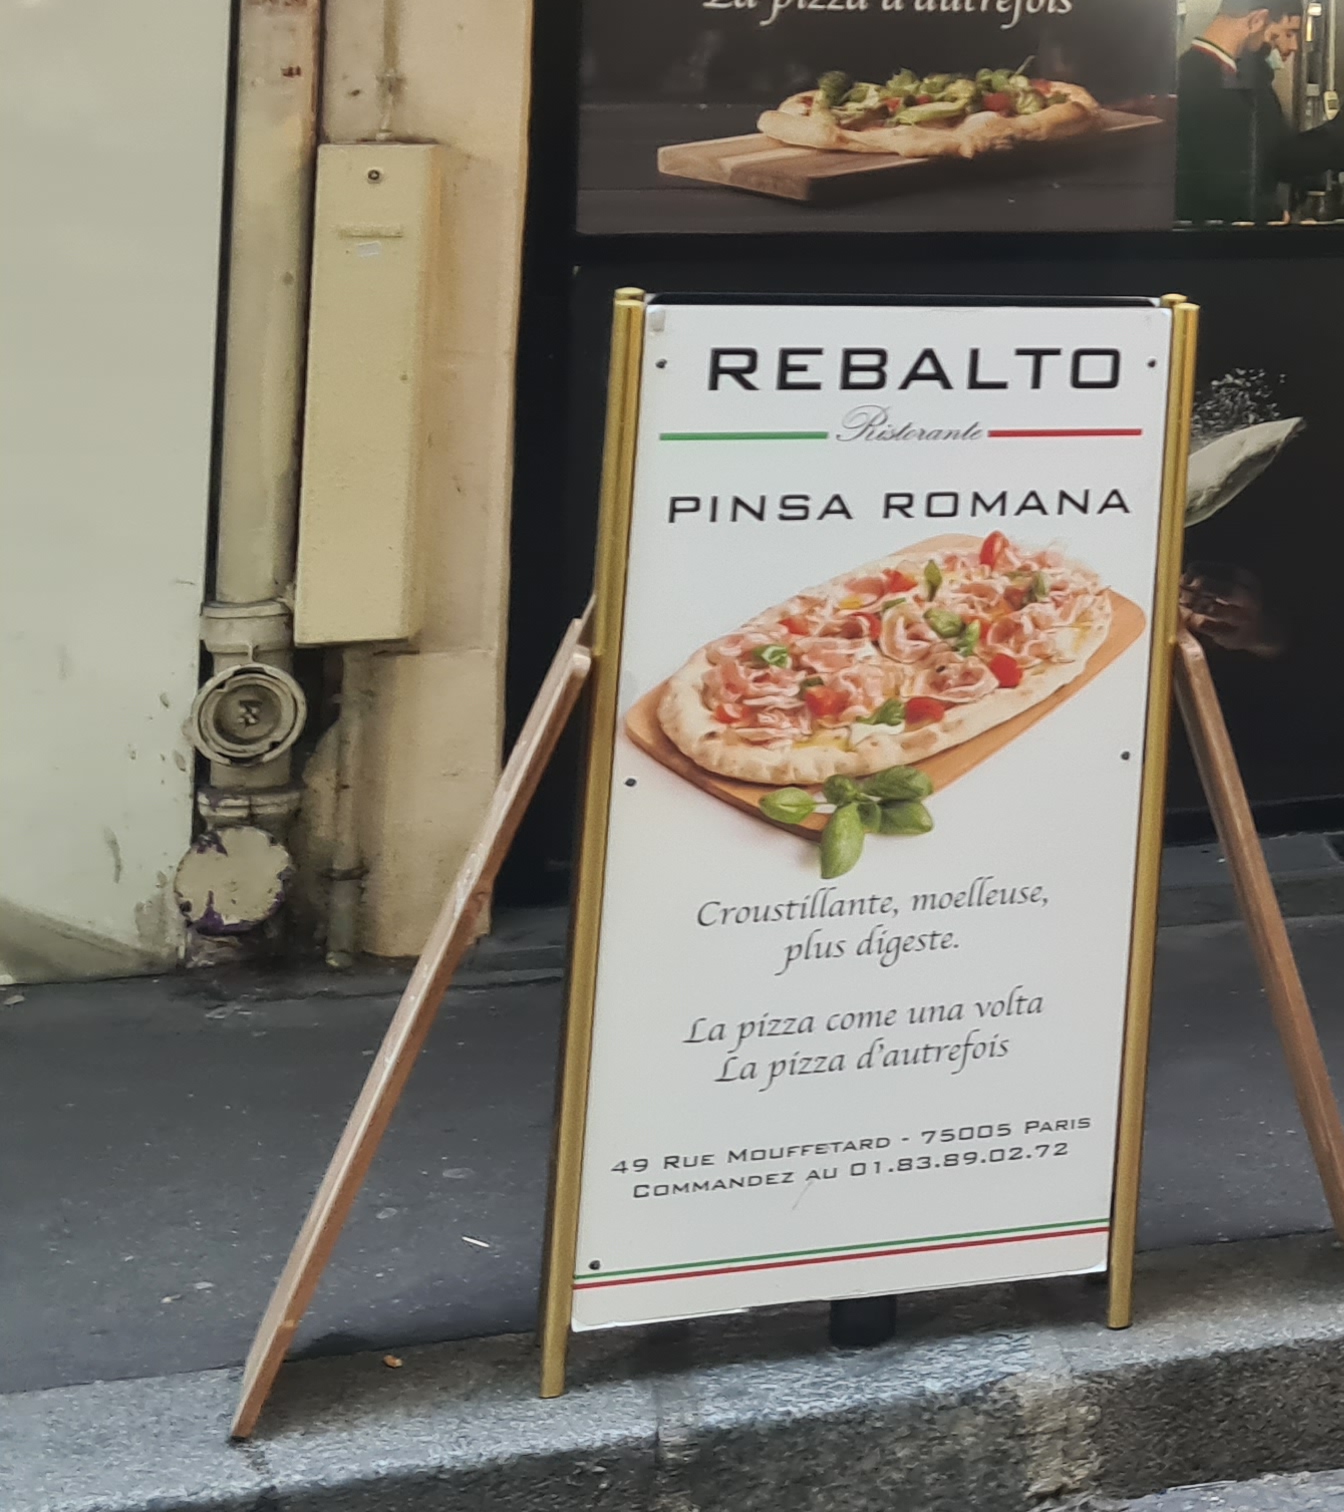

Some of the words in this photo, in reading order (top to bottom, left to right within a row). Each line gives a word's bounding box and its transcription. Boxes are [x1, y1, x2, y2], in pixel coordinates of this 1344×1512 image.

[708, 347, 1122, 390] REBALTO
[835, 404, 985, 443] Ristorante
[668, 494, 853, 523] PINSA
[882, 489, 1131, 519] ROMANA
[697, 885, 899, 928] Croustillante,
[912, 876, 1050, 915] moelleuse,
[774, 929, 846, 976] plus
[856, 924, 960, 967] digeste.
[683, 1016, 726, 1045] La
[728, 1011, 815, 1053] pizza
[826, 1006, 898, 1034] come
[908, 1002, 964, 1026] una
[975, 984, 1044, 1019] volta
[714, 1055, 757, 1084] La
[758, 1050, 846, 1092] pizza
[856, 1028, 1010, 1075] d'autrefois
[610, 1158, 649, 1176] 49
[662, 1153, 715, 1170] RUE
[727, 1134, 891, 1165] MOUFFETARD
[921, 1122, 1012, 1145] 75005
[1024, 1116, 1092, 1135] PARIS
[633, 1172, 795, 1200] COMMANDEZ
[806, 1166, 838, 1182] AU
[850, 1141, 1069, 1177] 01.83.89.02.72
